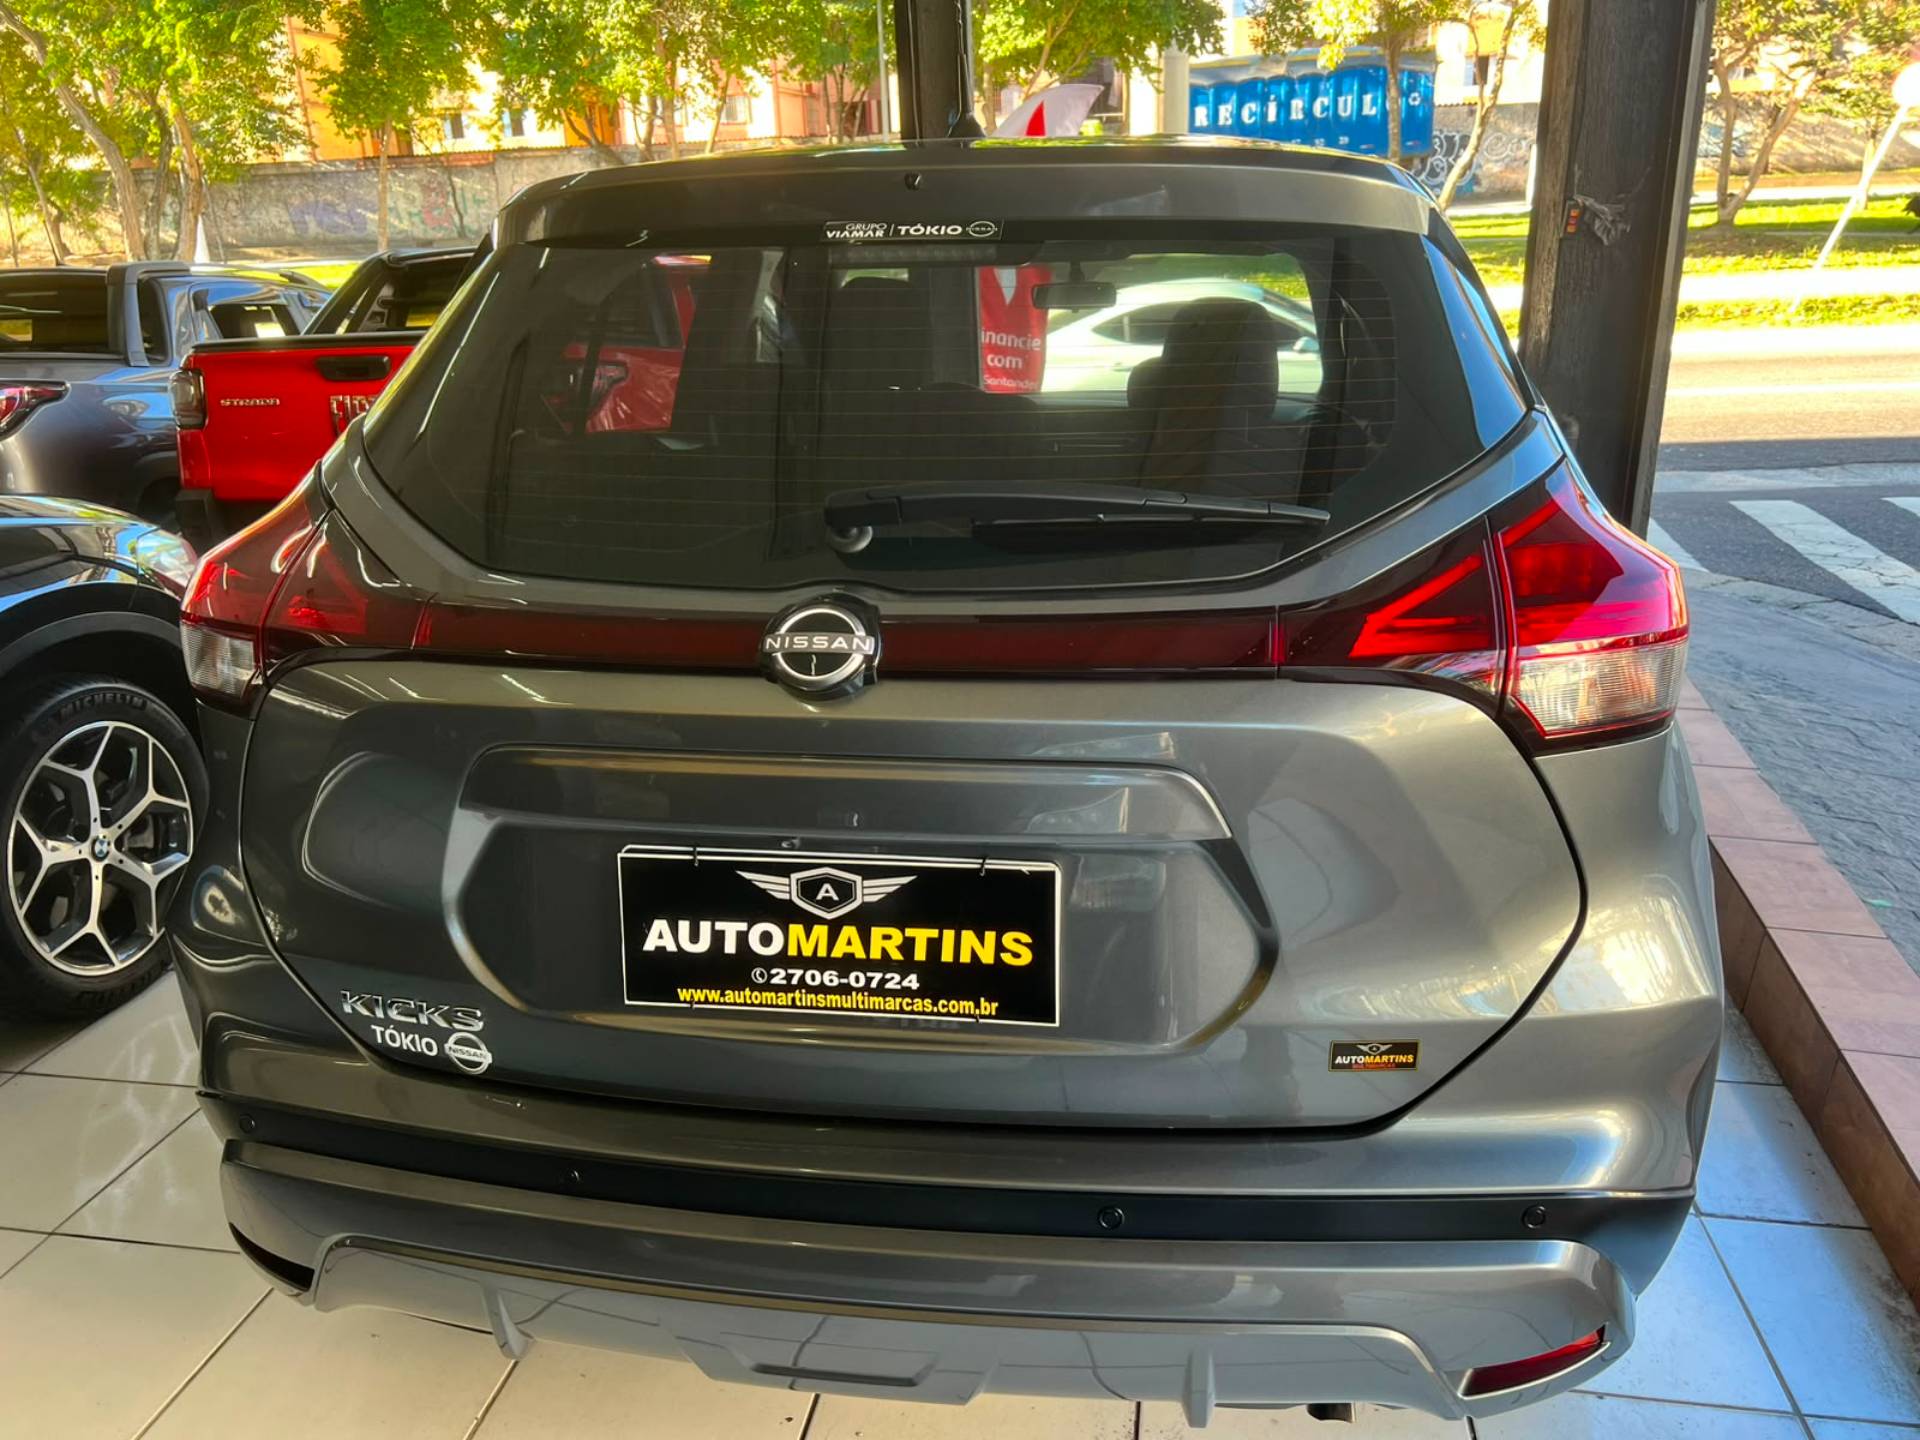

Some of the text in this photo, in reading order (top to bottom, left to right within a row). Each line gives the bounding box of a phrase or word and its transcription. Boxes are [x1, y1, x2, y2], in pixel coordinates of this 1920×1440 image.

[1194, 93, 1401, 128] RECÍRCUL
[826, 229, 885, 239] VIAMAR
[845, 223, 887, 231] GRUPO
[897, 223, 963, 236] TÓKIO
[986, 354, 1023, 369] com
[220, 398, 280, 407] STRADA
[765, 635, 871, 651] NISSAN
[815, 883, 840, 901] A
[642, 918, 1034, 967] AUTOMARTINS
[769, 967, 921, 991] 2706-0724
[677, 986, 999, 1016] www.automartinsmultimarcas.com.br
[340, 990, 485, 1032] KICKS
[370, 1024, 438, 1057] TÓKIO
[1334, 1054, 1414, 1065] AUTOMARTINS
